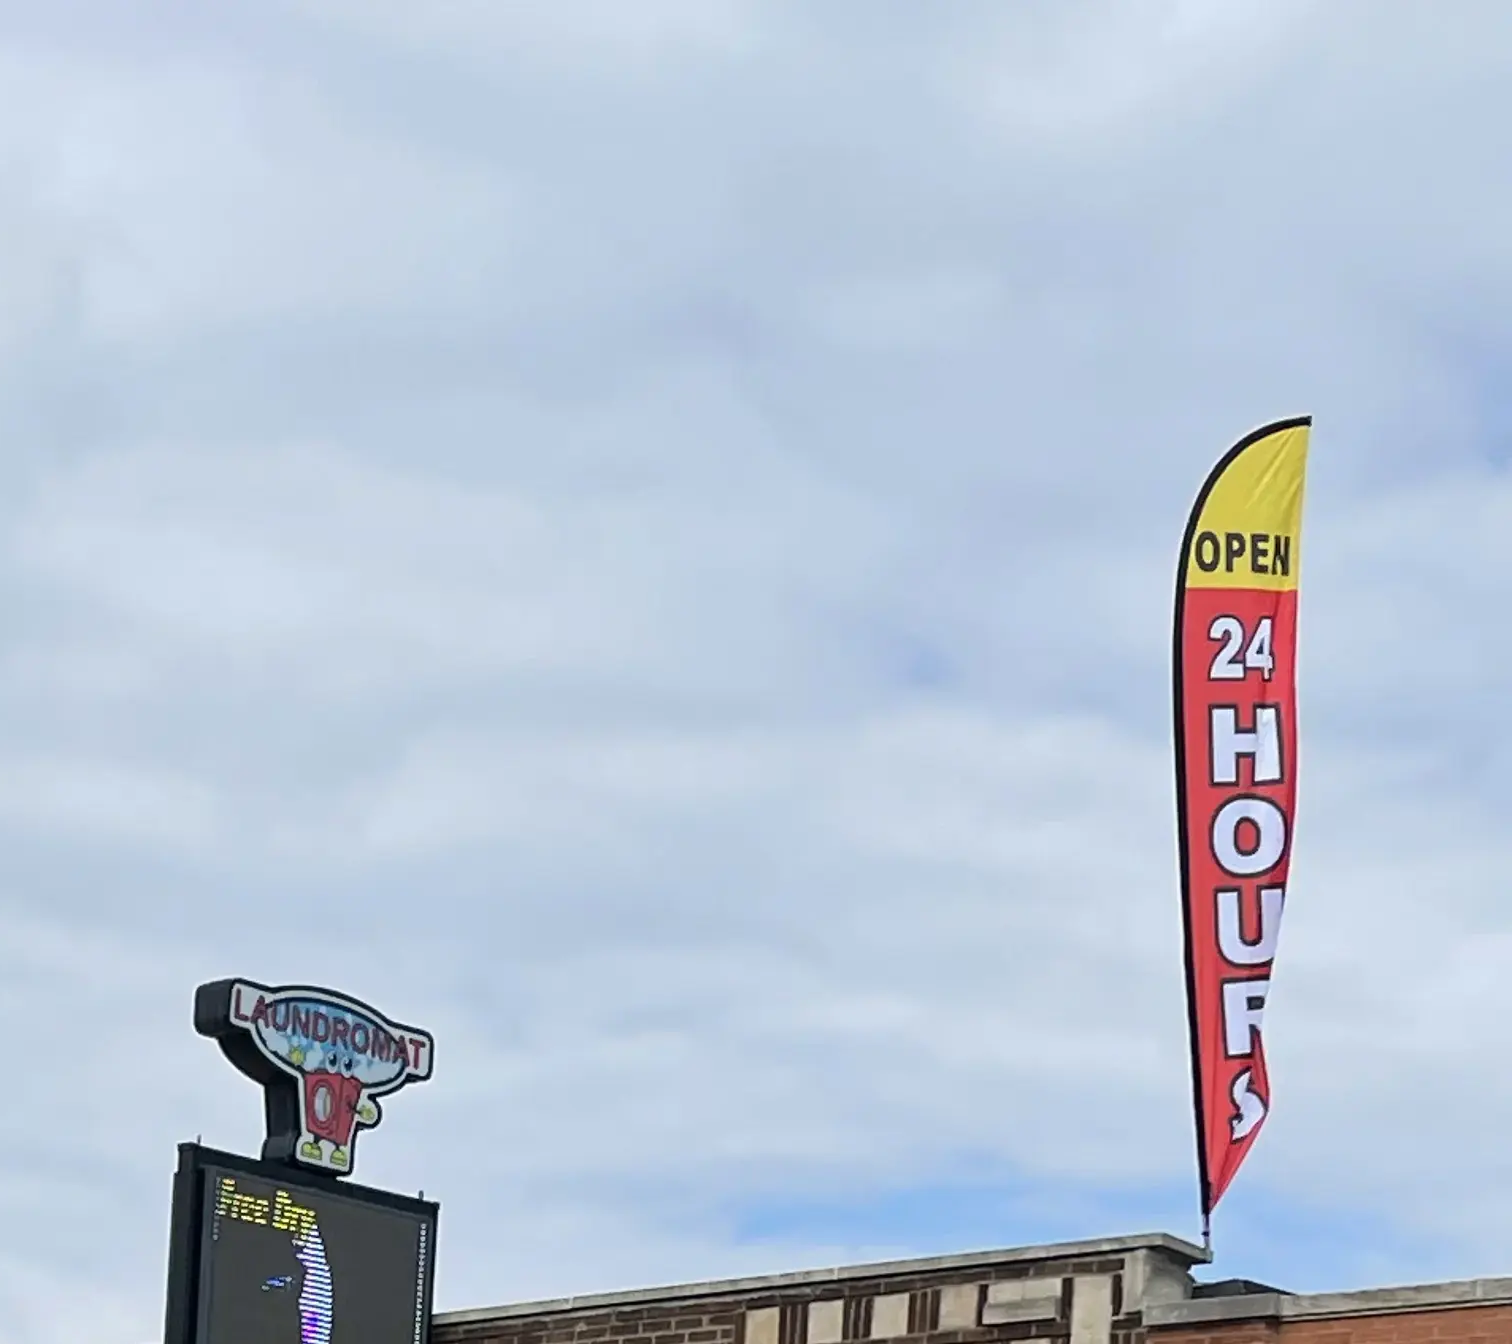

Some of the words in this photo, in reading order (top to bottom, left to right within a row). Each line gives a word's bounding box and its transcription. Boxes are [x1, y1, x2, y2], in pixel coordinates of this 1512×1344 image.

[1194, 529, 1291, 577] OPEN
[1207, 615, 1275, 681] 24
[1205, 702, 1287, 1146] HOURS
[234, 987, 426, 1070] LAUNDROMAT
